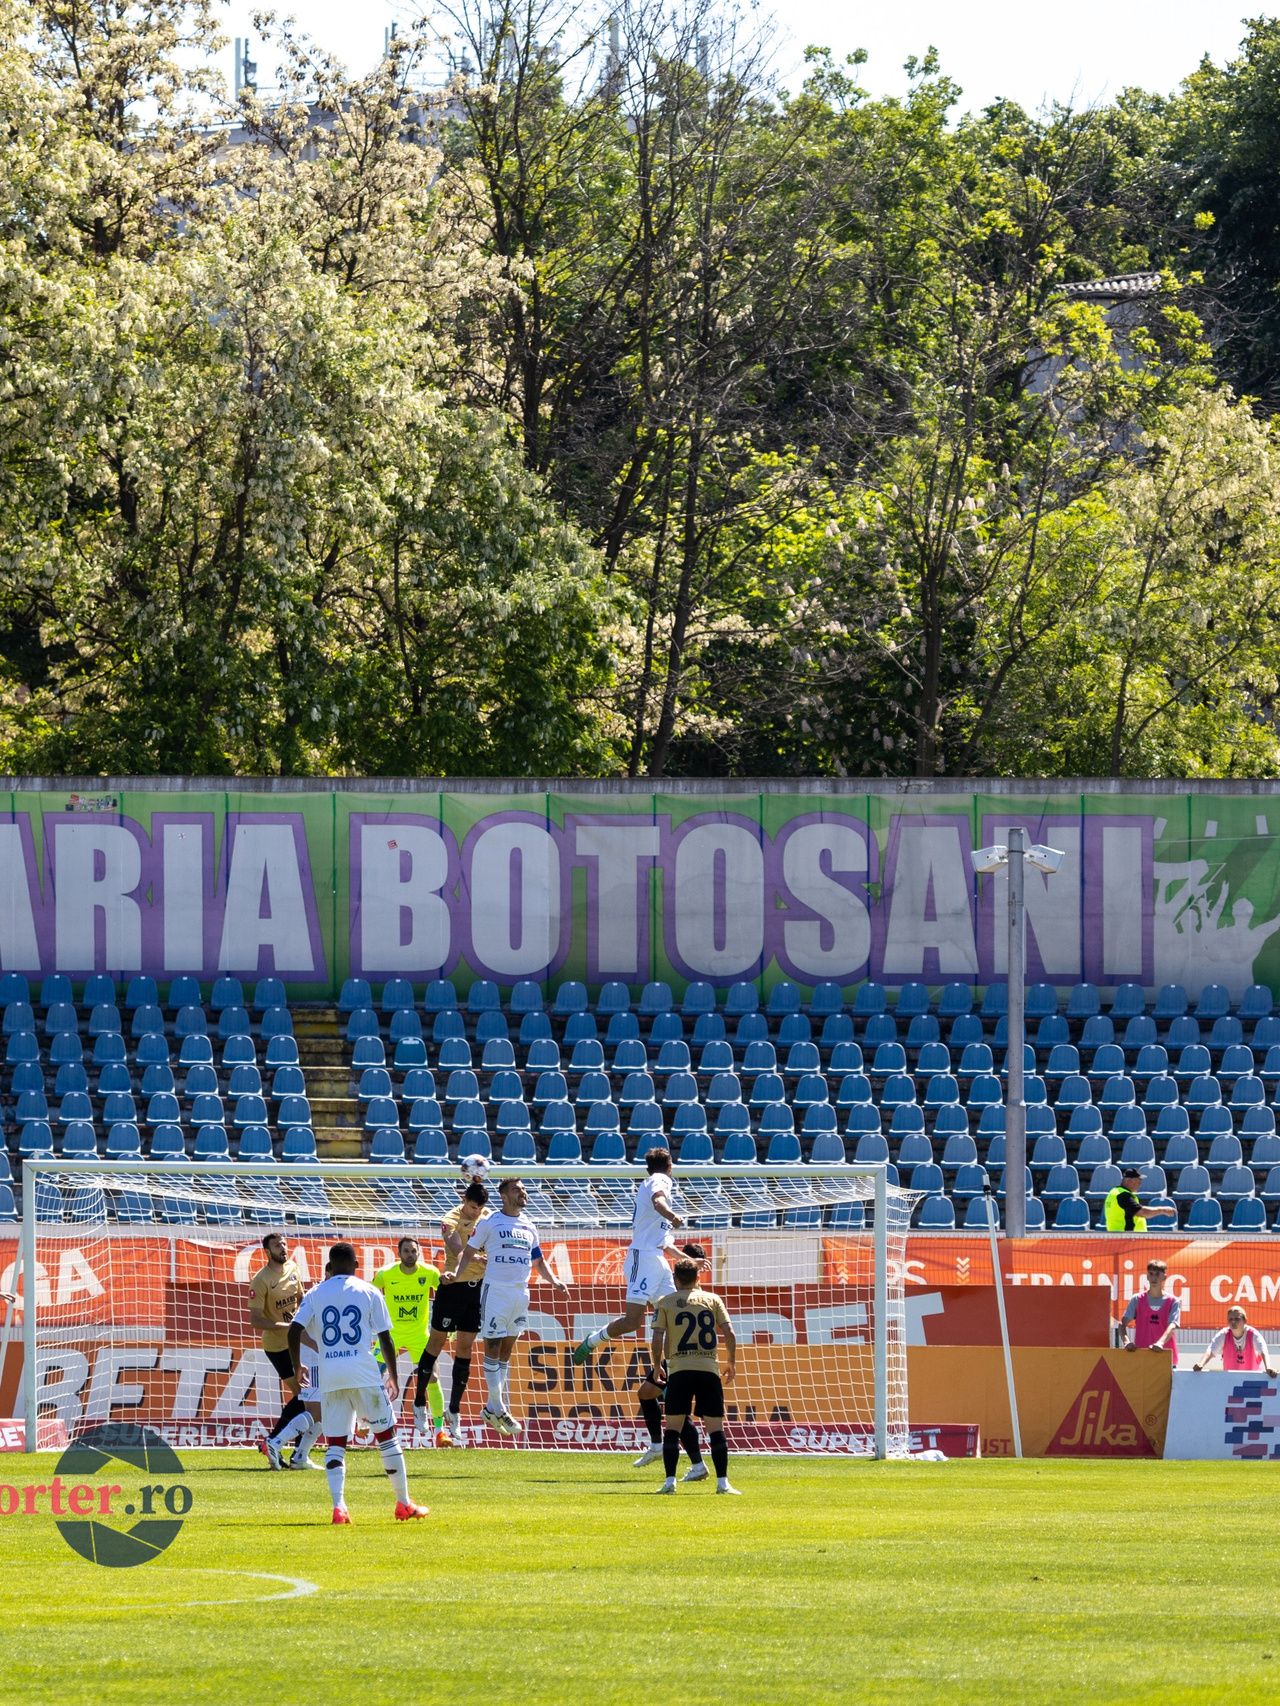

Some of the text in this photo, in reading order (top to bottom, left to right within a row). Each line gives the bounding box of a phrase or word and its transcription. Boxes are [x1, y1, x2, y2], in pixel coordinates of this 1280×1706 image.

[361, 823, 1144, 975] BOTOSANI
[640, 1278, 648, 1291] 6
[322, 1305, 362, 1347] 83
[489, 1317, 497, 1330] 4
[675, 1310, 717, 1351] 28
[528, 1346, 656, 1392] SIKA
[1060, 1390, 1138, 1446] Sika
[787, 1427, 941, 1452] SUPEBET
